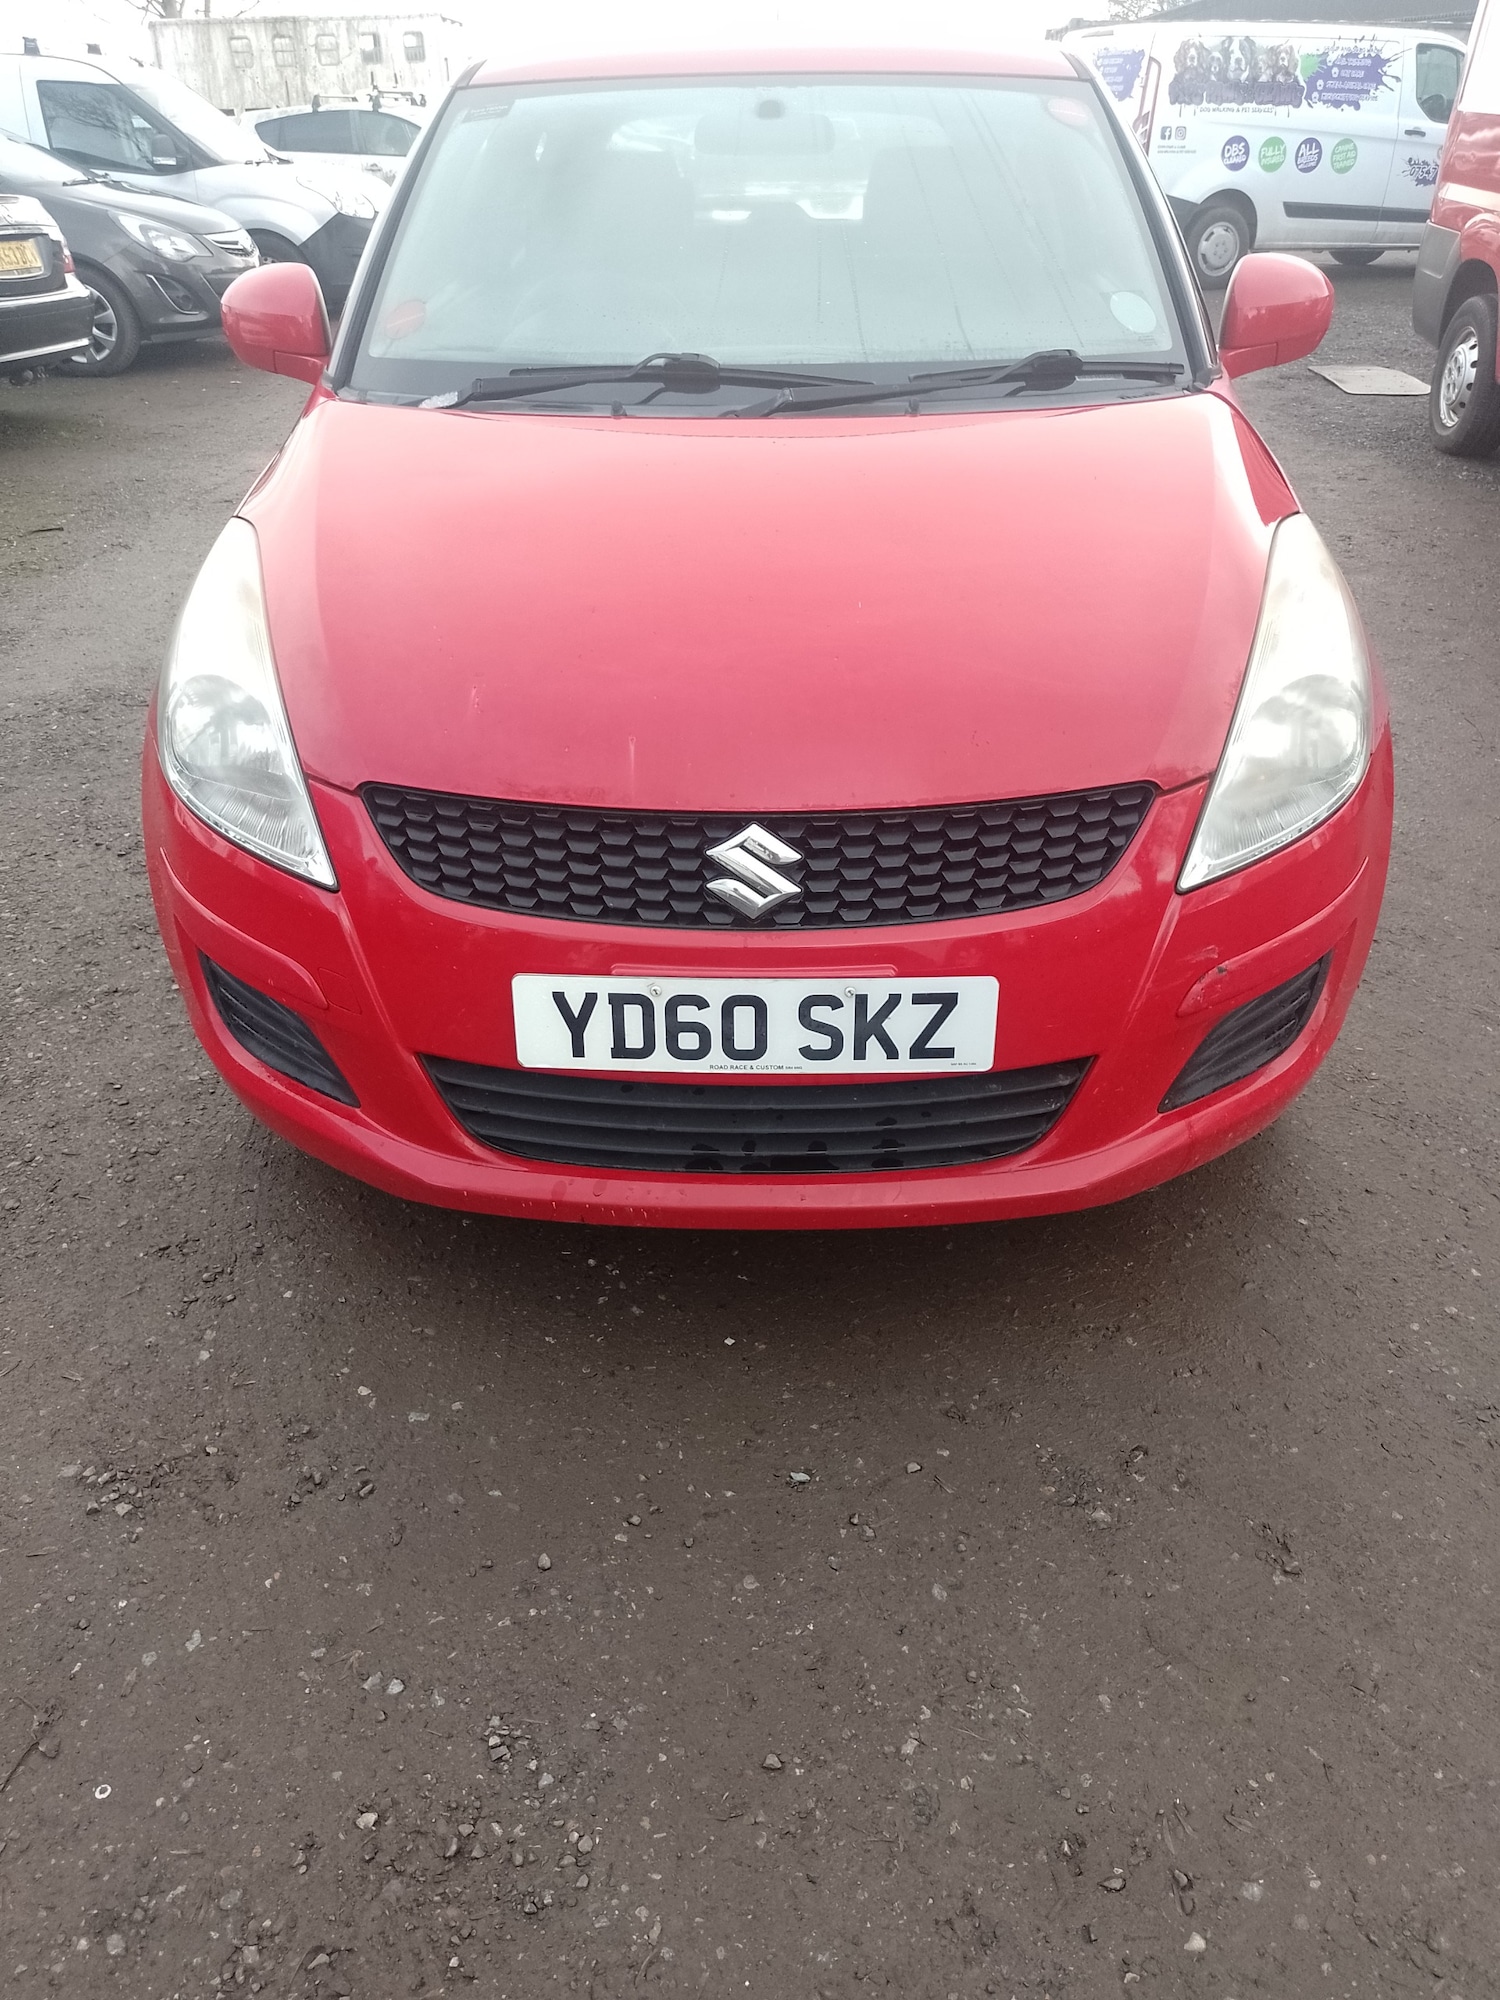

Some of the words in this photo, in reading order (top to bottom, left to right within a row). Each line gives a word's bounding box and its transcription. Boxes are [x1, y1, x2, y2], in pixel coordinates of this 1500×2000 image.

[1251, 106, 1274, 114] SERVICES
[1224, 142, 1246, 158] DBS
[1260, 144, 1286, 159] FULLY
[1298, 142, 1320, 157] ALL
[1223, 154, 1247, 165] CLEARED
[1260, 155, 1285, 166] INSURED
[1297, 154, 1319, 165] BREEDS
[1333, 153, 1347, 162] FIRST
[1346, 151, 1357, 159] AID
[1409, 166, 1439, 181] 07547
[551, 991, 768, 1061] YD60
[798, 992, 959, 1061] SKZ
